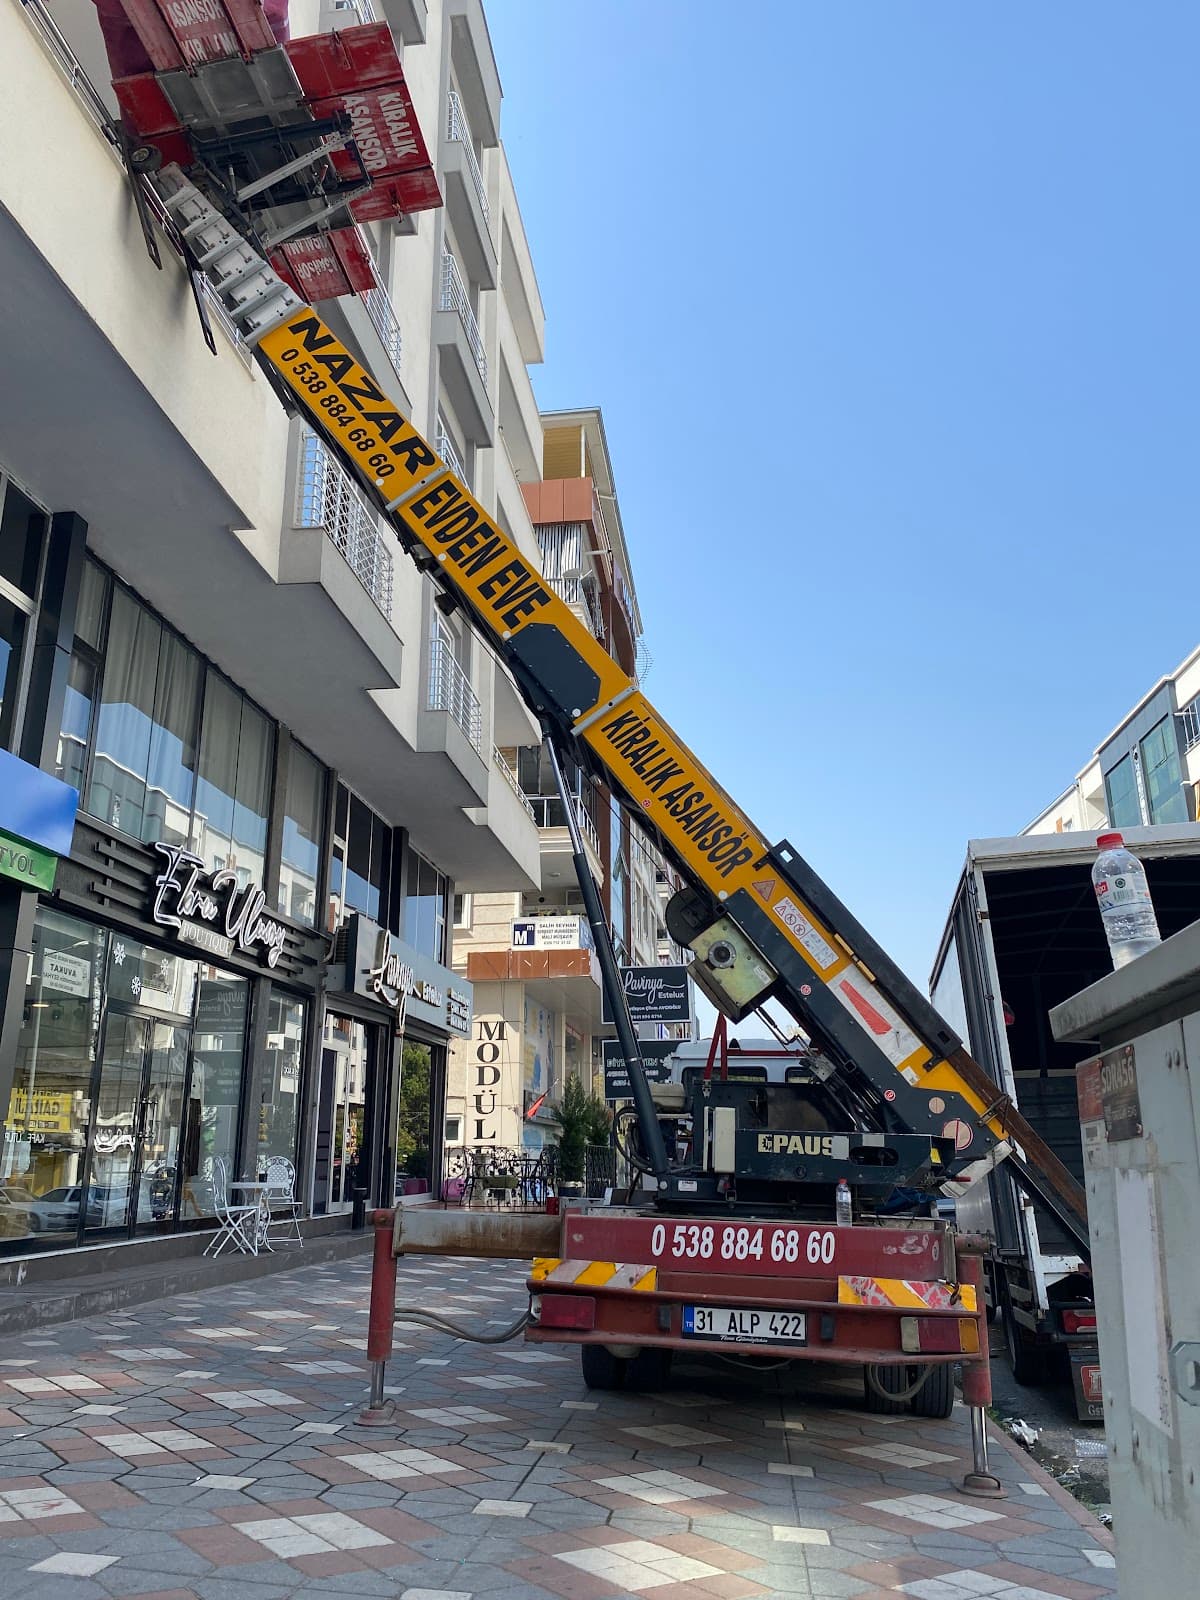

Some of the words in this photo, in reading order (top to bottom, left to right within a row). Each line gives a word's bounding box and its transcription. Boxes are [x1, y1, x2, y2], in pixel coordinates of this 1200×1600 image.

[341, 96, 391, 172] ASANSÖR
[377, 92, 419, 158] KİRALIK
[281, 348, 299, 362] 0
[293, 362, 328, 394] 538
[320, 394, 356, 427] 884
[348, 428, 376, 452] 68
[368, 453, 396, 478] 60
[288, 316, 436, 475] NAZAR
[409, 479, 508, 577] EVDEN
[477, 559, 552, 629] EVE
[601, 709, 684, 793] KİRALIK
[657, 781, 753, 878] ASANSÖR
[624, 970, 684, 1004] Lavinya
[658, 991, 685, 999] Estelux
[472, 1020, 508, 1153] MODÜL
[652, 1224, 666, 1257] 0
[672, 1225, 714, 1259] 538
[721, 1227, 763, 1261] 884
[771, 1229, 799, 1262] 68
[807, 1231, 835, 1264] 60
[696, 1310, 713, 1332] 31
[727, 1312, 760, 1333] ALP
[769, 1314, 801, 1337] 422
